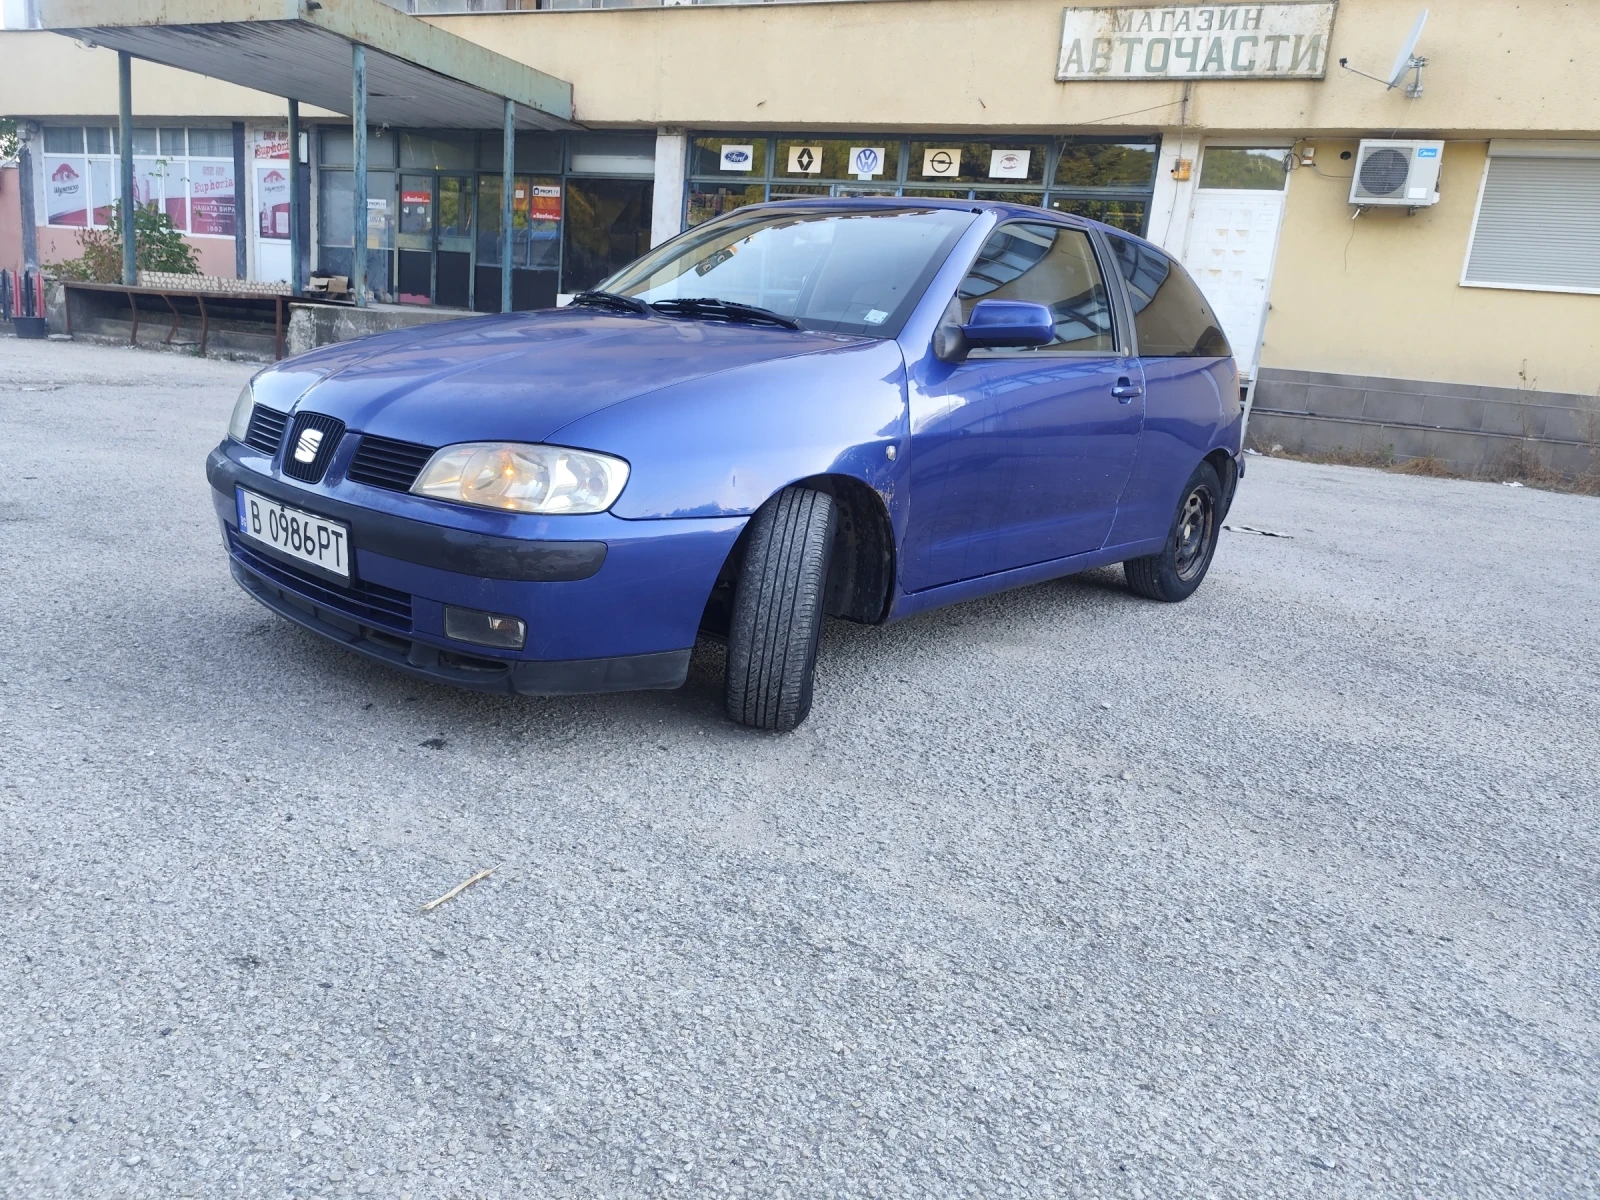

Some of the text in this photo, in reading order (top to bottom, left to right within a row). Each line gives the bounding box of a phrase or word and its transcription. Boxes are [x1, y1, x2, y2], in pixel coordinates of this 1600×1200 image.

[1112, 8, 1264, 33] МАГАЗИН
[1061, 34, 1323, 73] АВТОЧАСТИ
[256, 141, 289, 158] Euphori
[726, 152, 746, 162] Ford
[194, 178, 234, 194] Euphoria
[251, 500, 343, 567] B 0986PT
